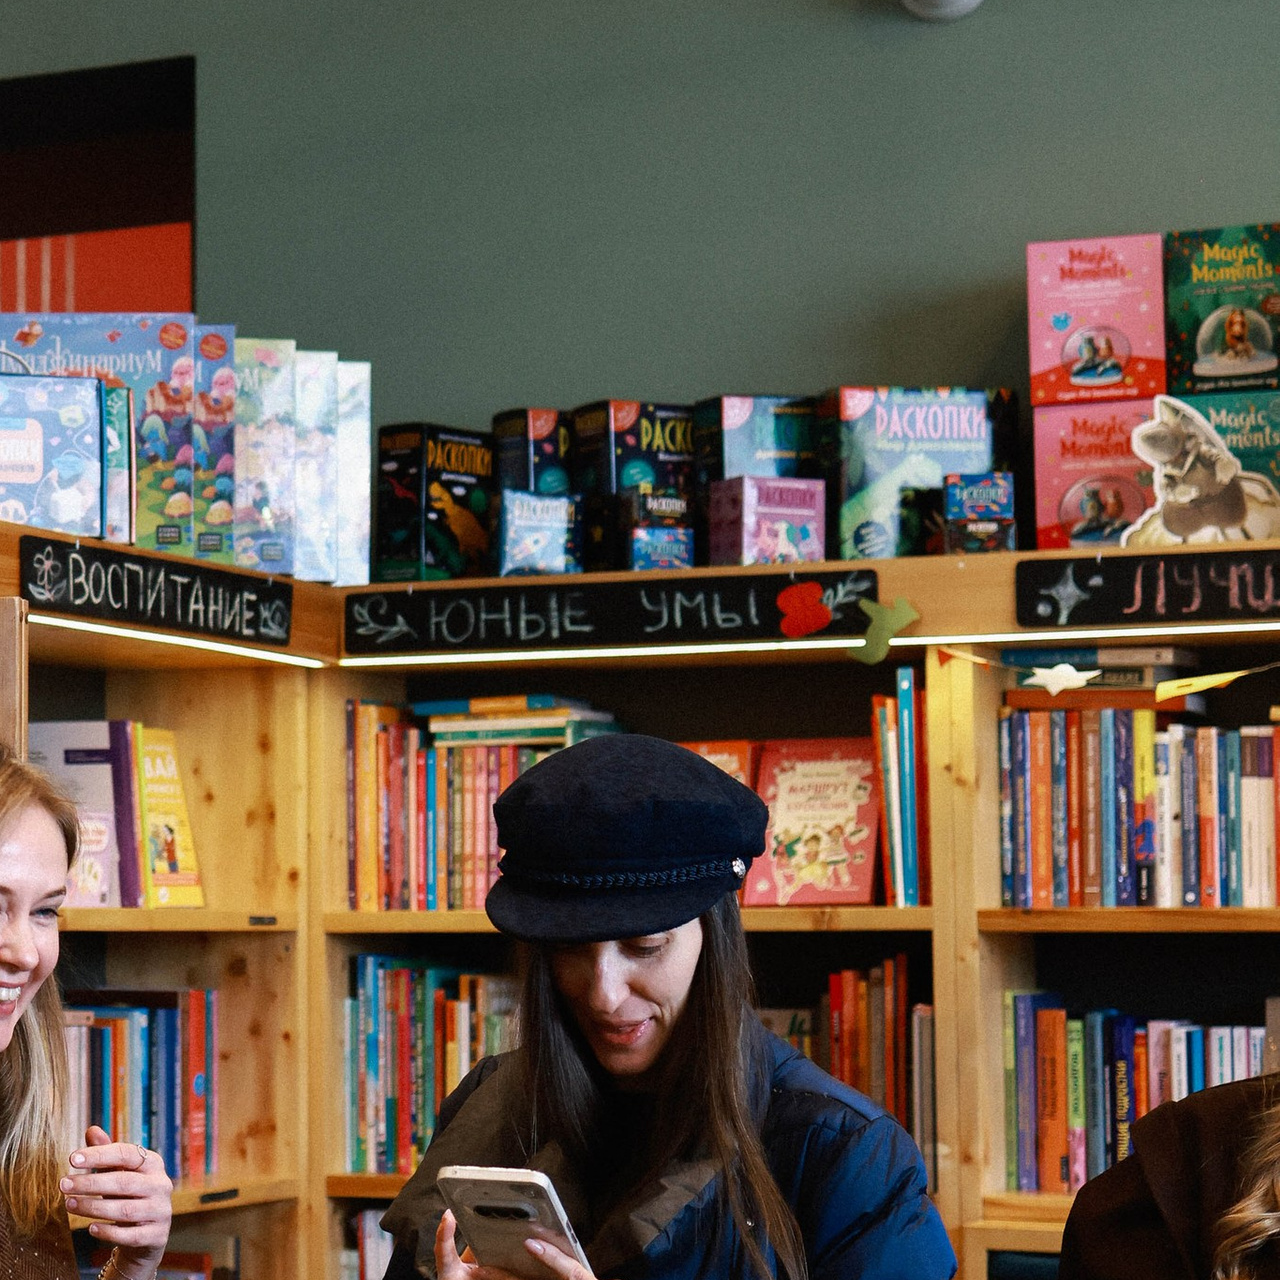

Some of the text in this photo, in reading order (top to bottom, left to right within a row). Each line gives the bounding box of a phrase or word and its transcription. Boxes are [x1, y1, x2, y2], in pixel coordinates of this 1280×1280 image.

[1203, 242, 1260, 266] Magic
[1191, 260, 1273, 283] Moments
[875, 403, 986, 440] РАСКОПКИ
[1209, 406, 1267, 432] Magic
[1227, 426, 1280, 448] ments
[426, 438, 493, 476] РАСКОПКИ
[68, 552, 258, 638] ВОСПИТАНИЕ
[429, 589, 758, 643] ЮНЫЕ УМЫ
